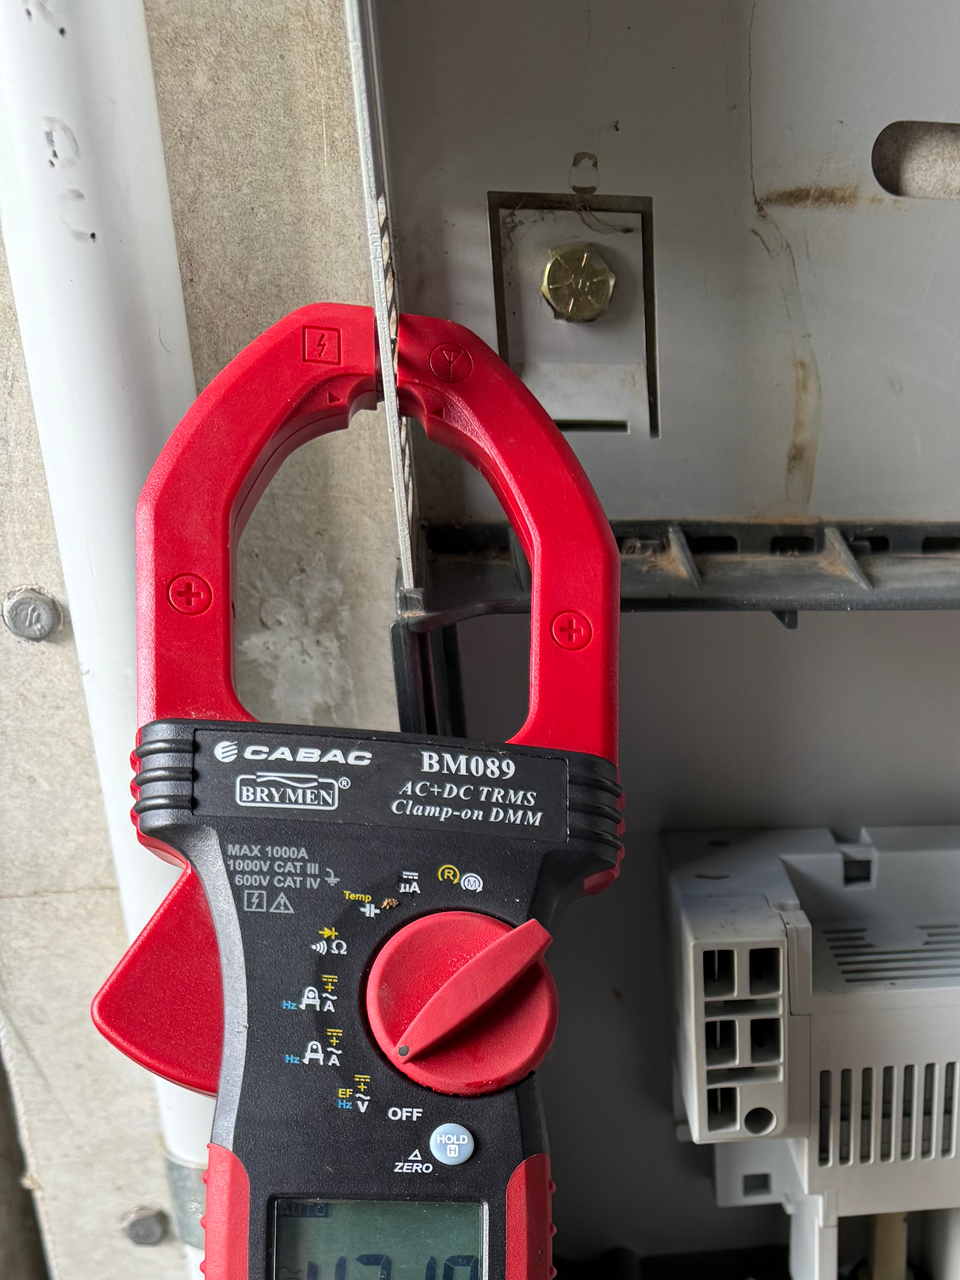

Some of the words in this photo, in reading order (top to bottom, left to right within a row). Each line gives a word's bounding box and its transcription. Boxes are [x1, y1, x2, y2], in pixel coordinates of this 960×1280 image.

[244, 745, 373, 766] CABAC
[420, 751, 516, 779] BM089
[241, 785, 334, 805] BRYMEN
[399, 780, 475, 802] AC+DC
[478, 786, 538, 808] TRMS
[391, 798, 484, 823] Clamp-on
[487, 807, 544, 827] DMM
[227, 844, 261, 857] MAX
[265, 845, 309, 859] 1000A
[226, 859, 270, 873] 1000V
[273, 861, 303, 874] CAT
[306, 863, 319, 875] III
[235, 875, 270, 887] 600V
[273, 875, 303, 888] CAT
[306, 877, 320, 889] IV
[343, 890, 372, 903] Temp
[282, 1000, 297, 1010] Hz
[323, 1001, 335, 1012] A
[285, 1054, 300, 1064] Hz
[328, 1055, 340, 1067] A
[338, 1089, 353, 1098] EF
[337, 1100, 352, 1109] Hz
[357, 1101, 369, 1113] V
[388, 1107, 423, 1122] OFF
[436, 1134, 468, 1145] HOLD
[394, 1162, 433, 1173] ZERO
